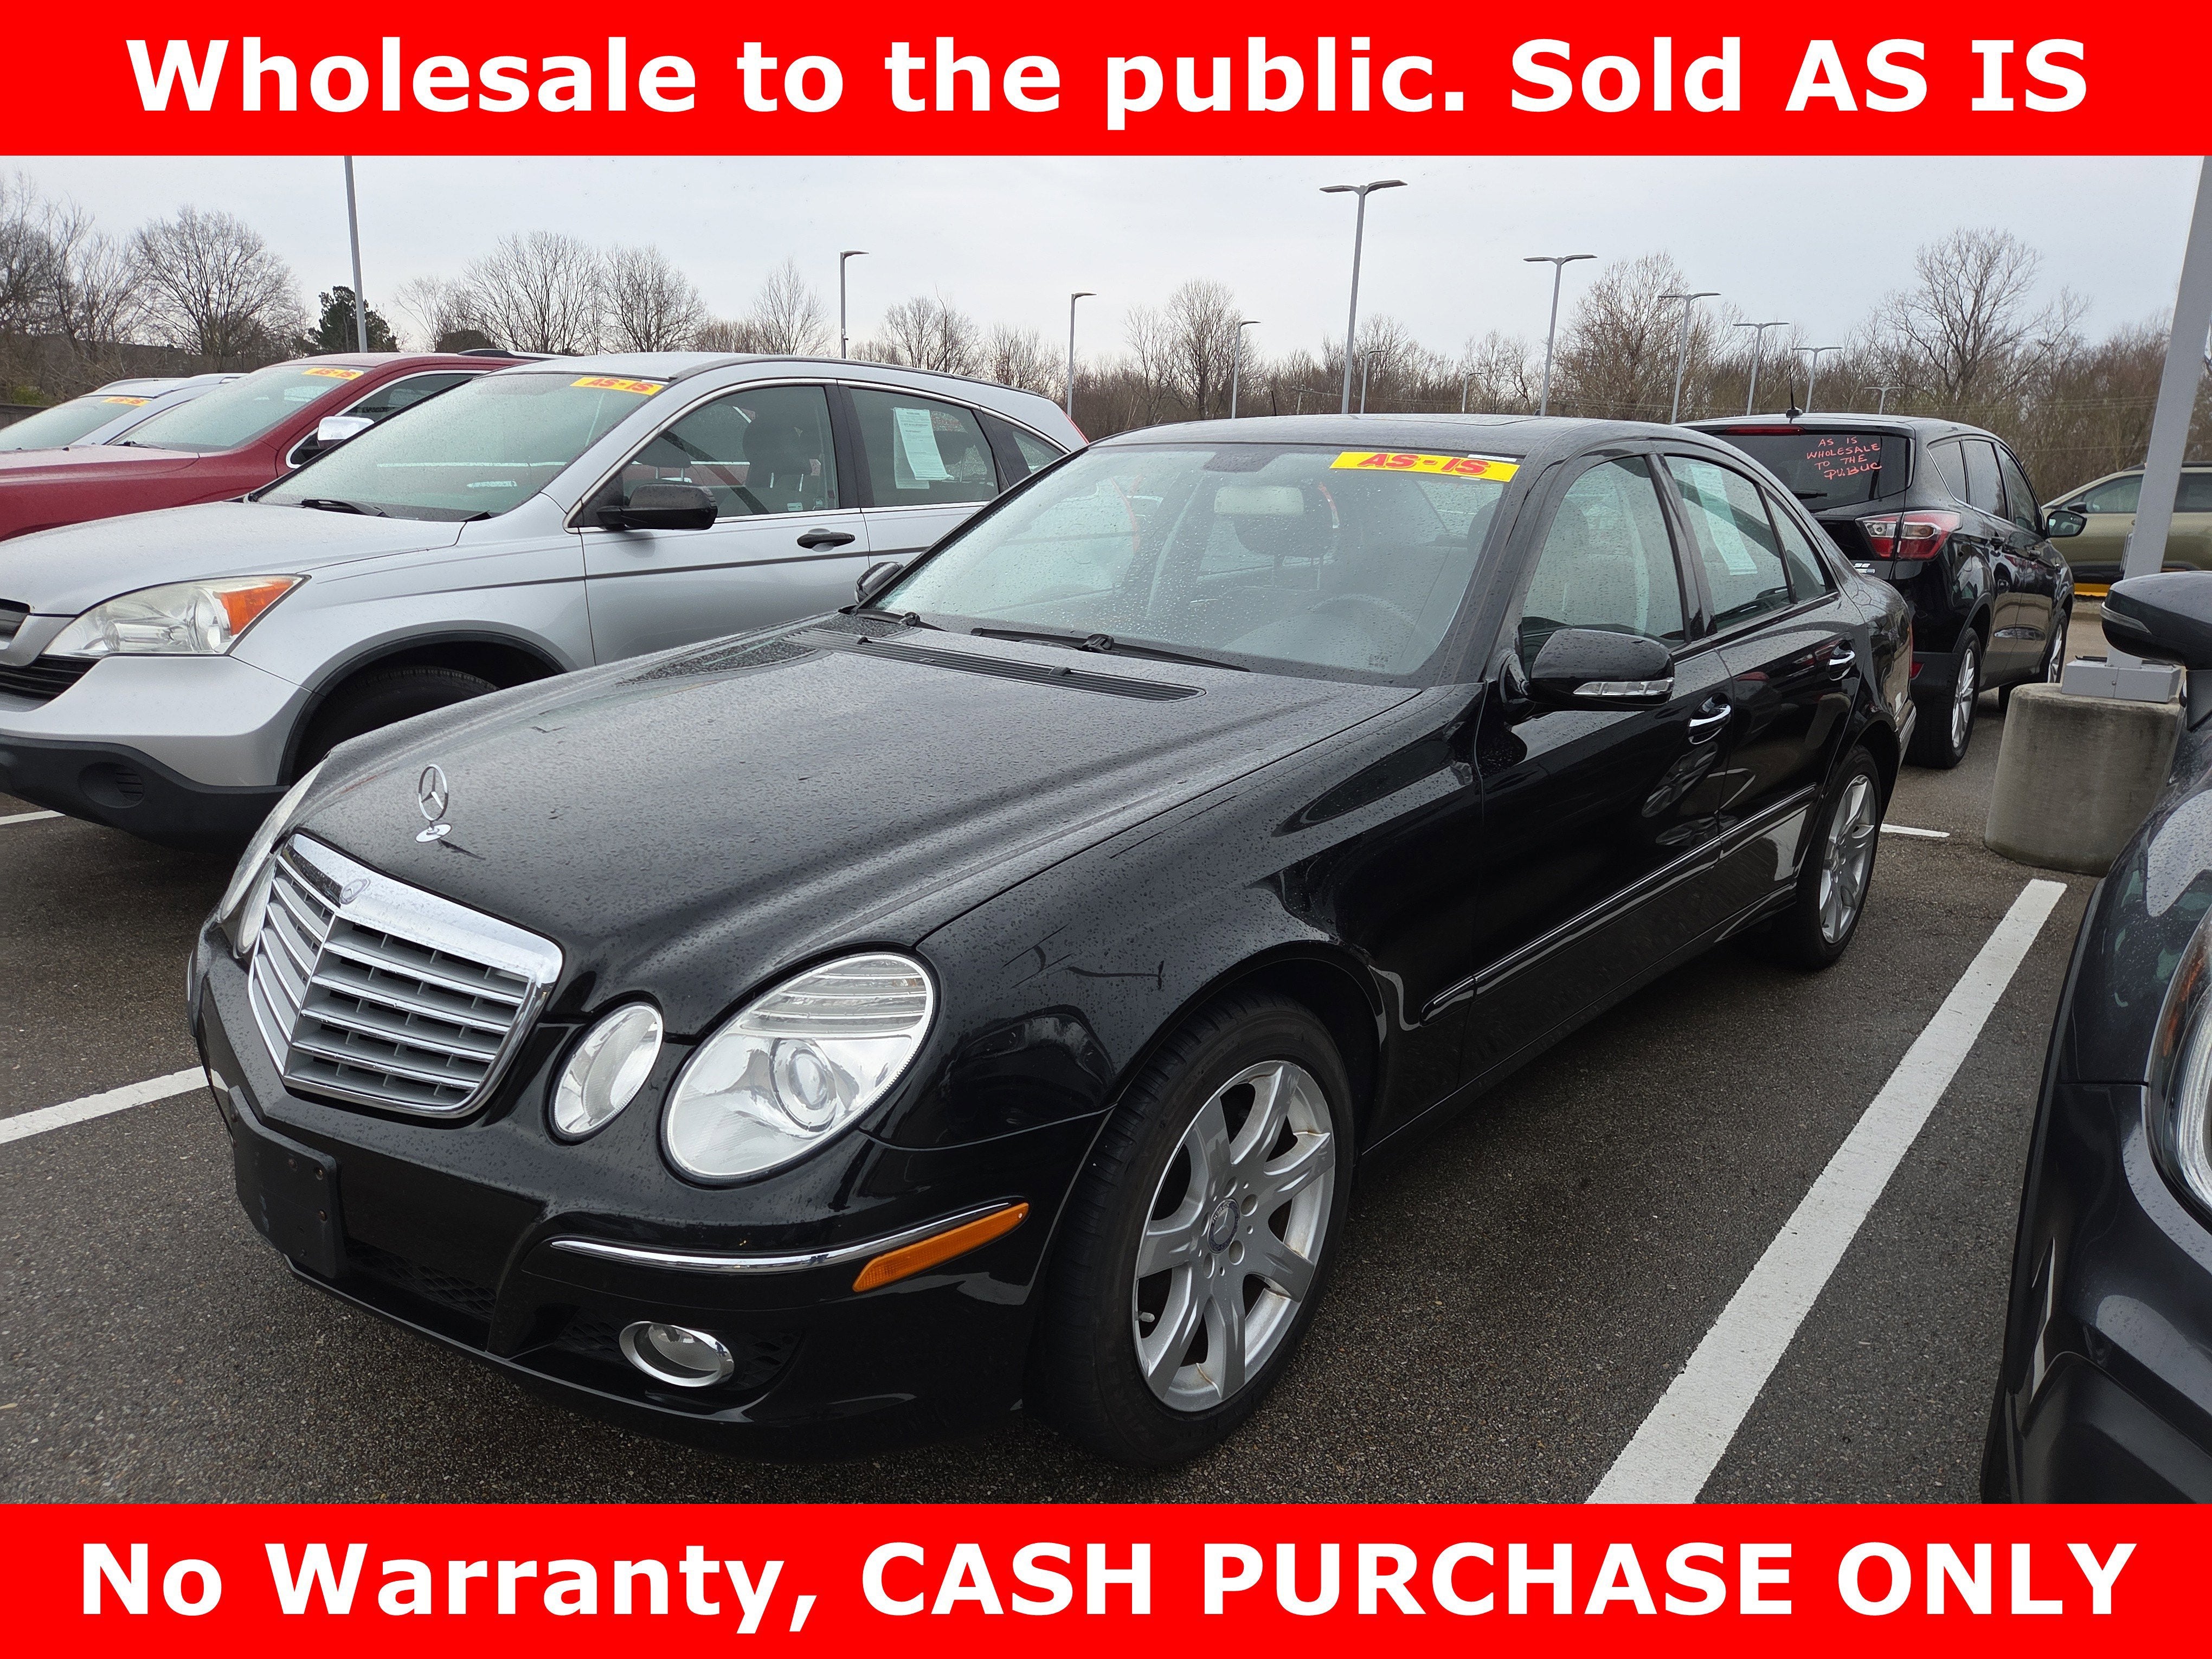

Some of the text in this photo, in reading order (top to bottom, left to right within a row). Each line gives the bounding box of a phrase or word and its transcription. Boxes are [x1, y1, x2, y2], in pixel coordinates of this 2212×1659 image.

[1818, 436, 1857, 447] AS IS
[1806, 443, 1881, 459] WHOLESALE
[1814, 454, 1868, 470] TO THE
